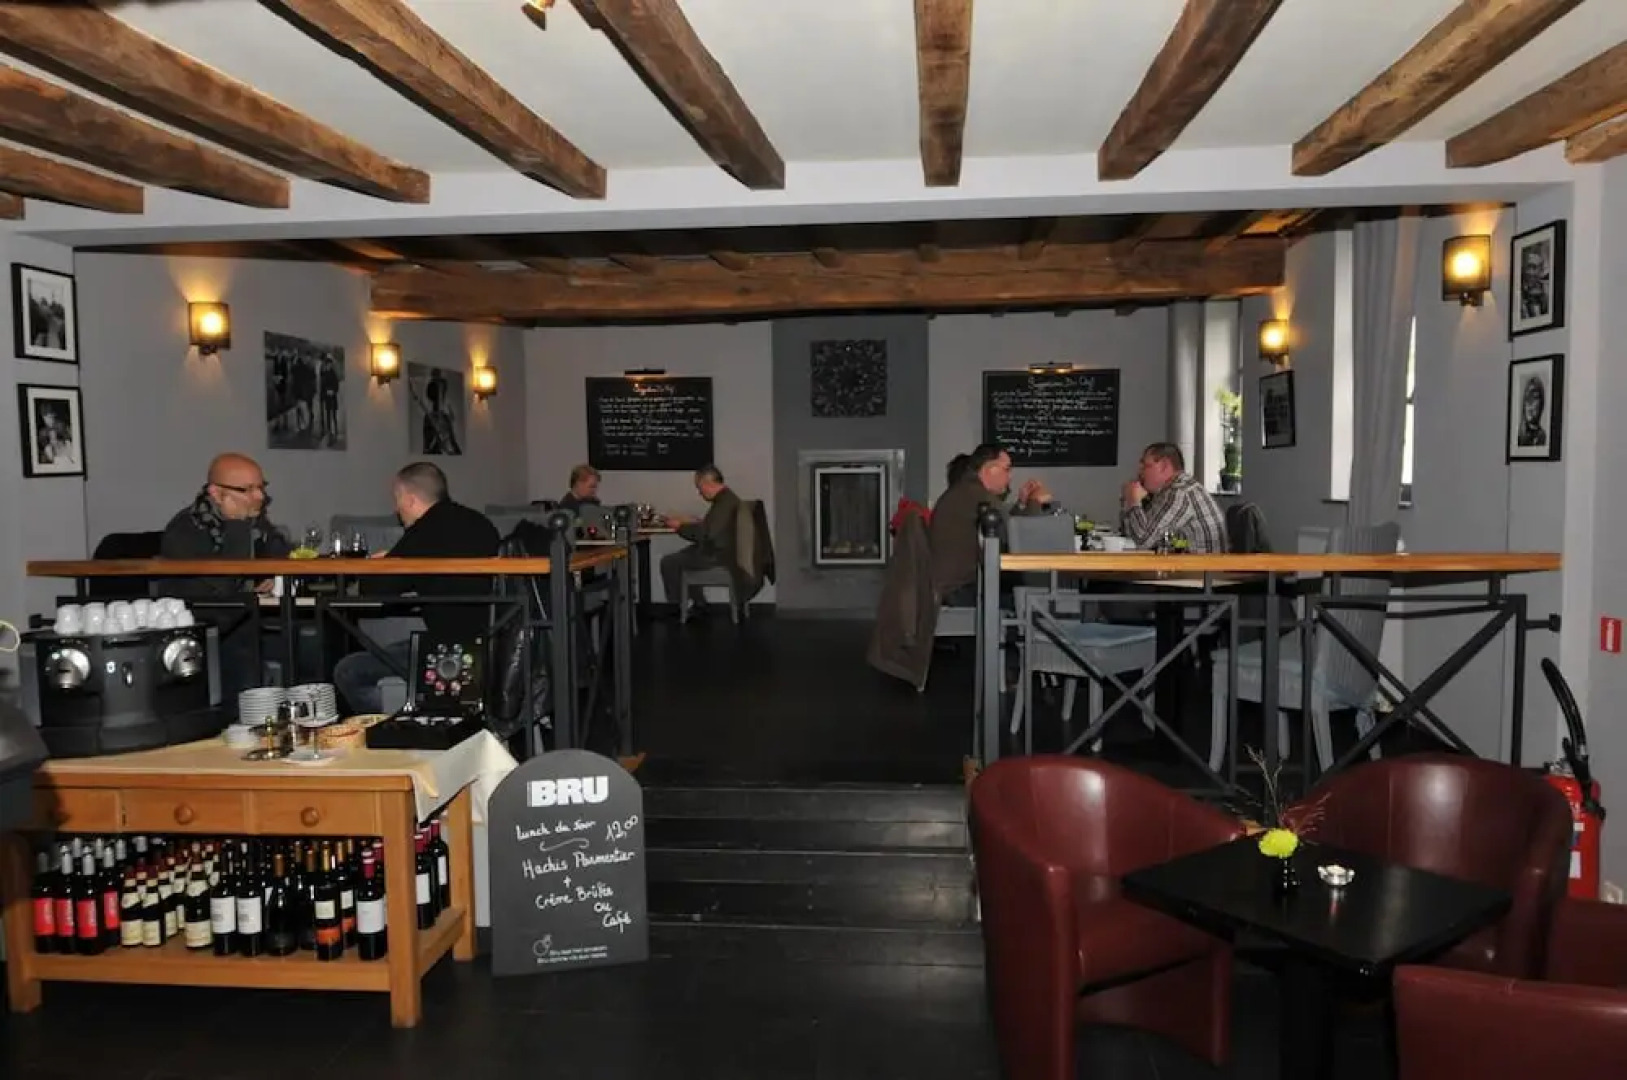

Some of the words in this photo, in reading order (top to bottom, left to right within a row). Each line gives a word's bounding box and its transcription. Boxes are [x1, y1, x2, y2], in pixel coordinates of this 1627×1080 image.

[528, 776, 609, 807] BRU
[516, 822, 550, 841] Lunch
[522, 855, 568, 879] Hachis
[594, 902, 612, 913] ou
